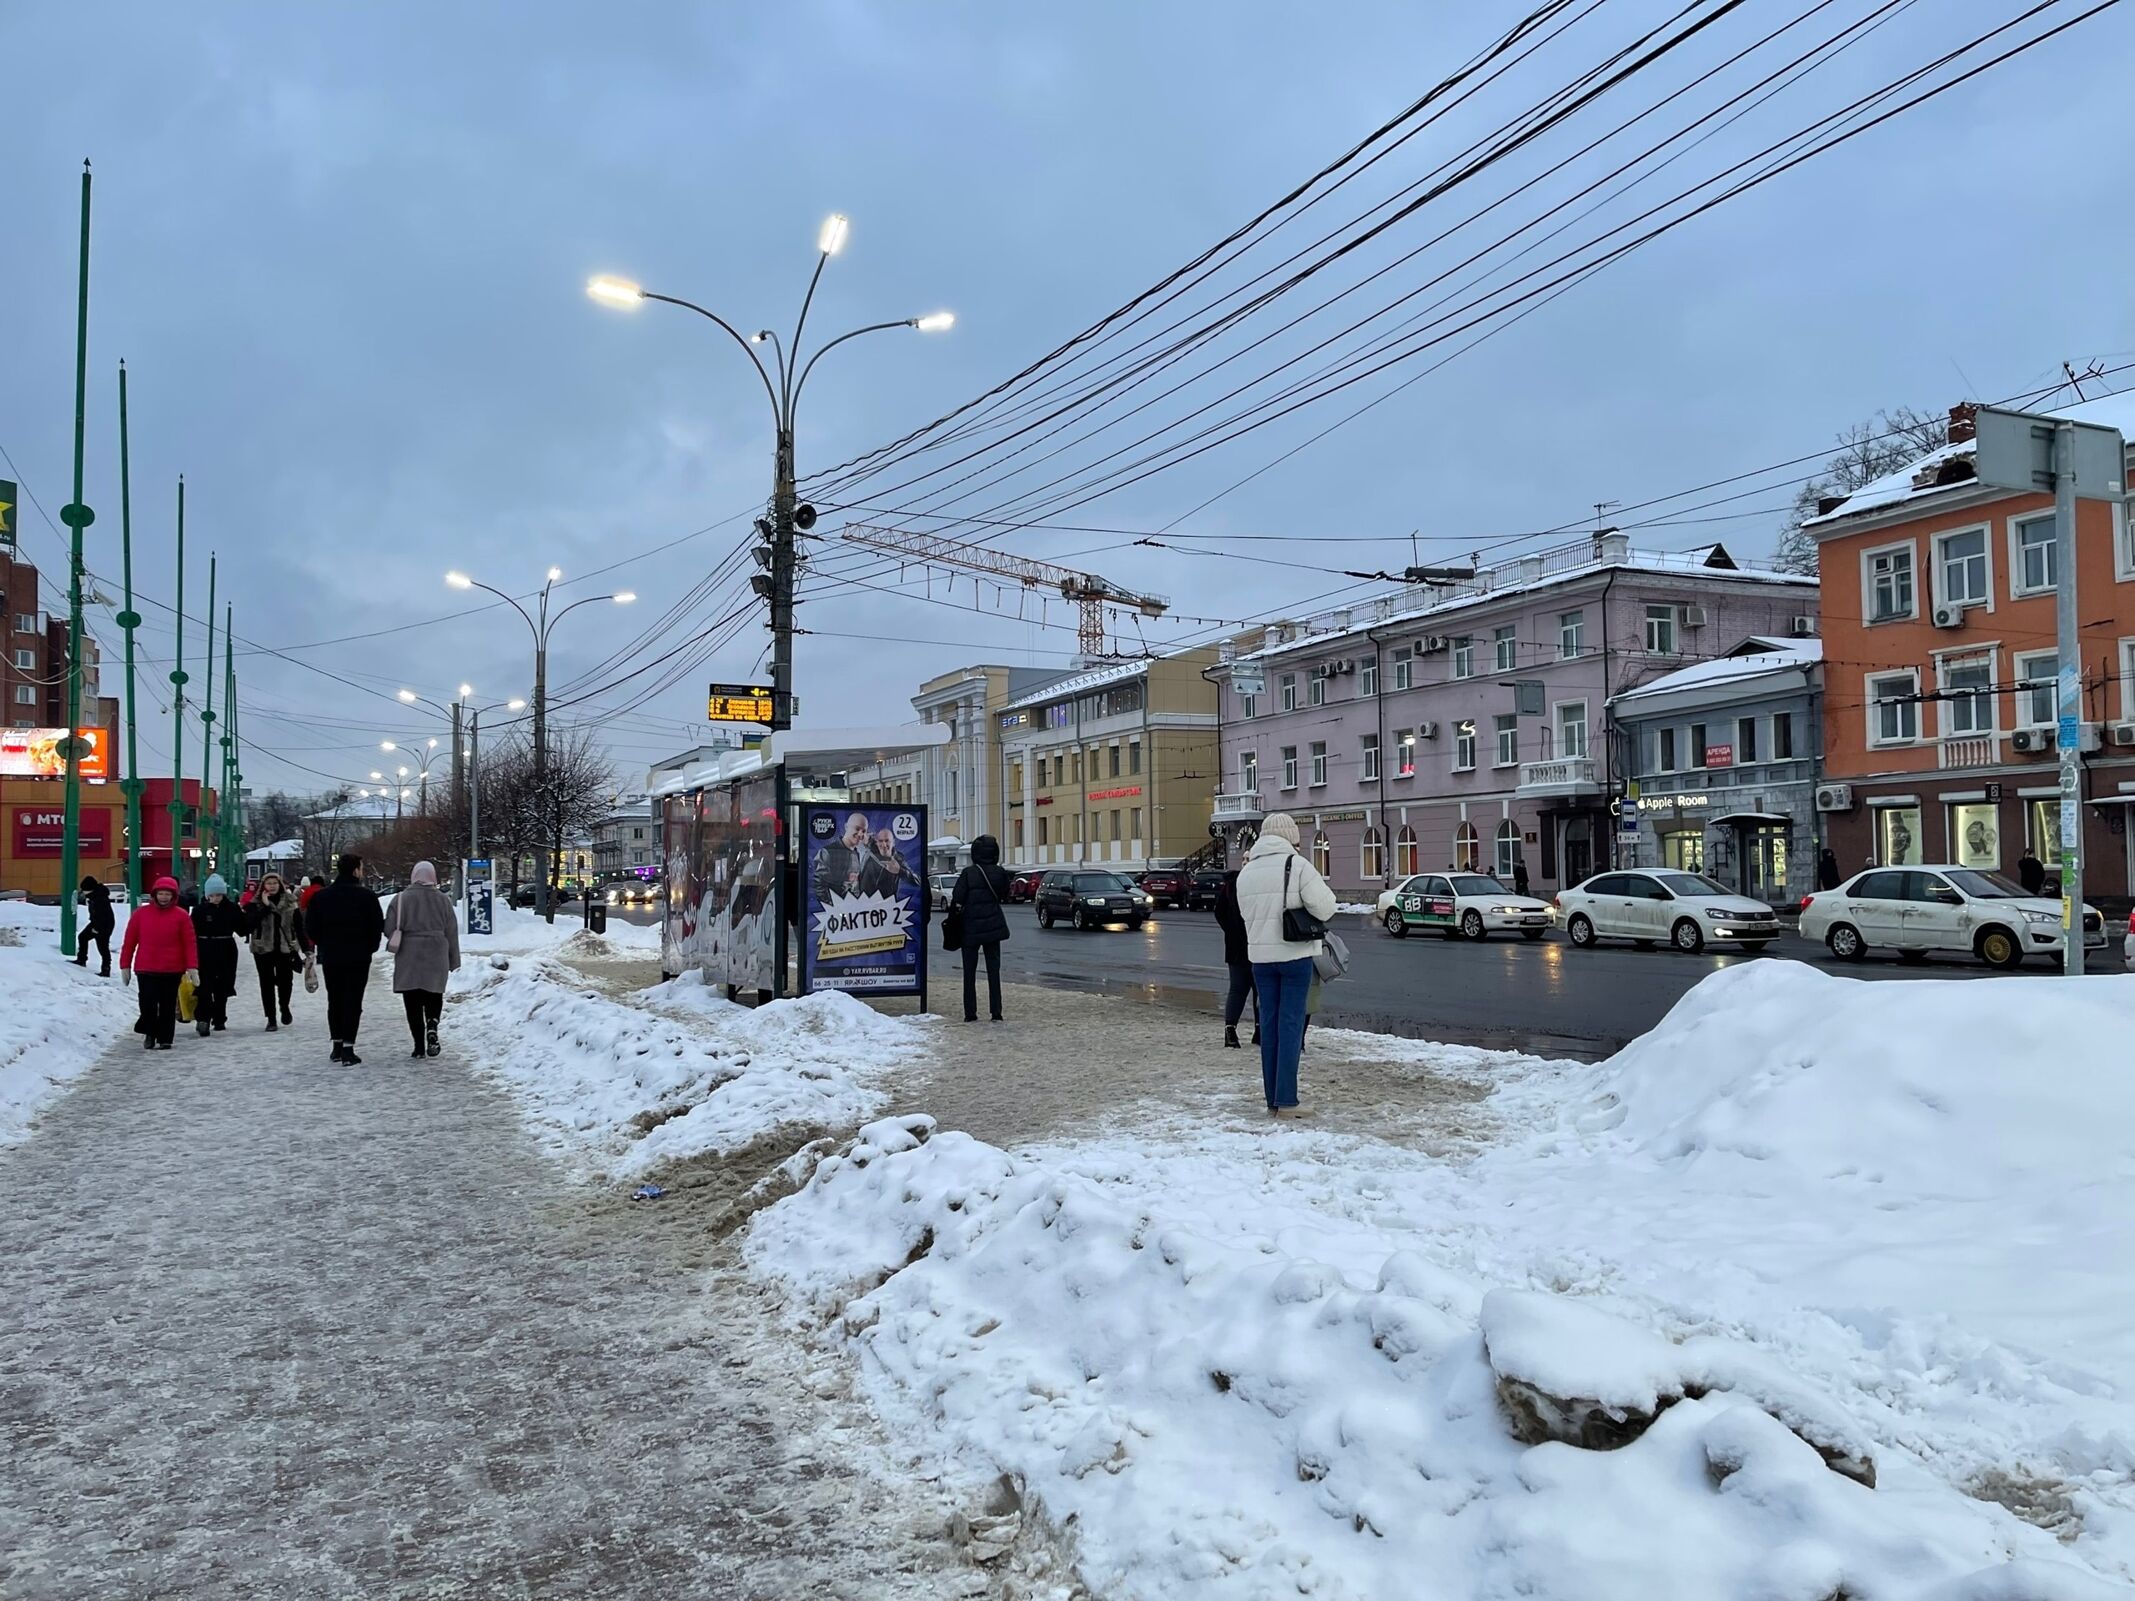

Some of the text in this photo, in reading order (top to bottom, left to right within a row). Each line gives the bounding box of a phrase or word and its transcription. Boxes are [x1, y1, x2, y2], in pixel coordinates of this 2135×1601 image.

[1646, 795, 1708, 810] Apple Room
[899, 816, 912, 829] 22
[827, 907, 902, 933] ФАКТОР 2
